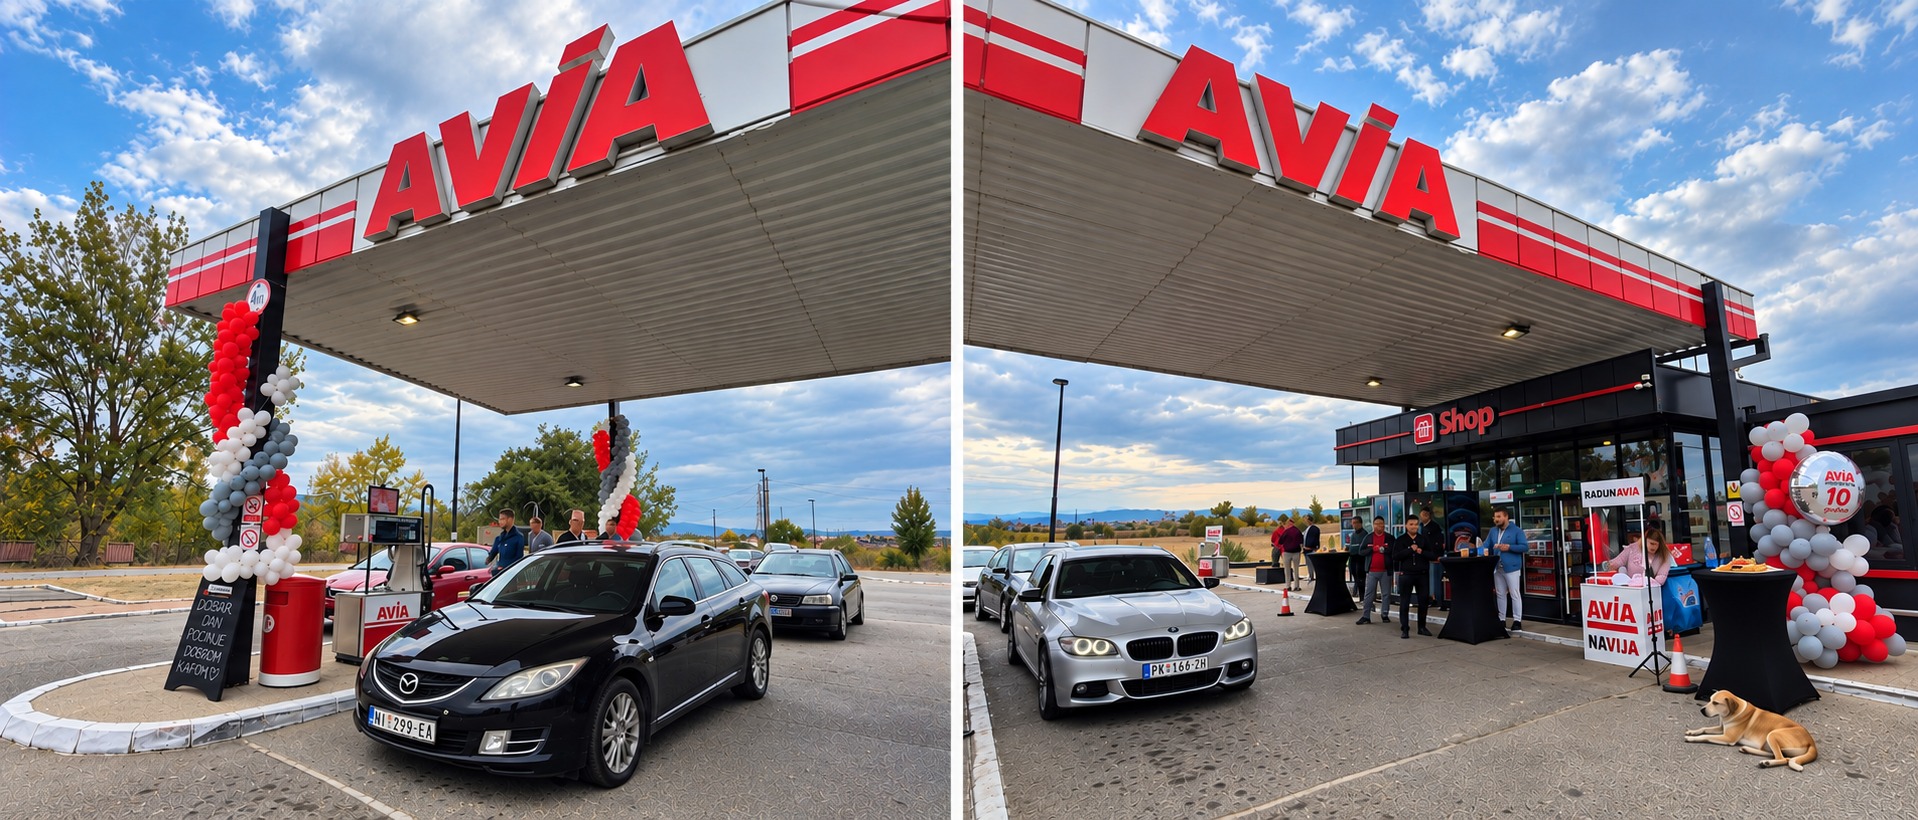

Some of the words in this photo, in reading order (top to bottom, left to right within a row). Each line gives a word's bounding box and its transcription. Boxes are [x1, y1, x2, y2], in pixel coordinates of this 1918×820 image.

[1439, 406, 1494, 436] Shop
[1827, 487, 1851, 507] 10
[196, 598, 233, 615] DOBAR
[201, 614, 224, 629] DAN
[1588, 634, 1639, 656] NAVIJA
[1151, 664, 1164, 676] PK
[374, 710, 385, 727] NI
[393, 717, 432, 740] 299-EA
